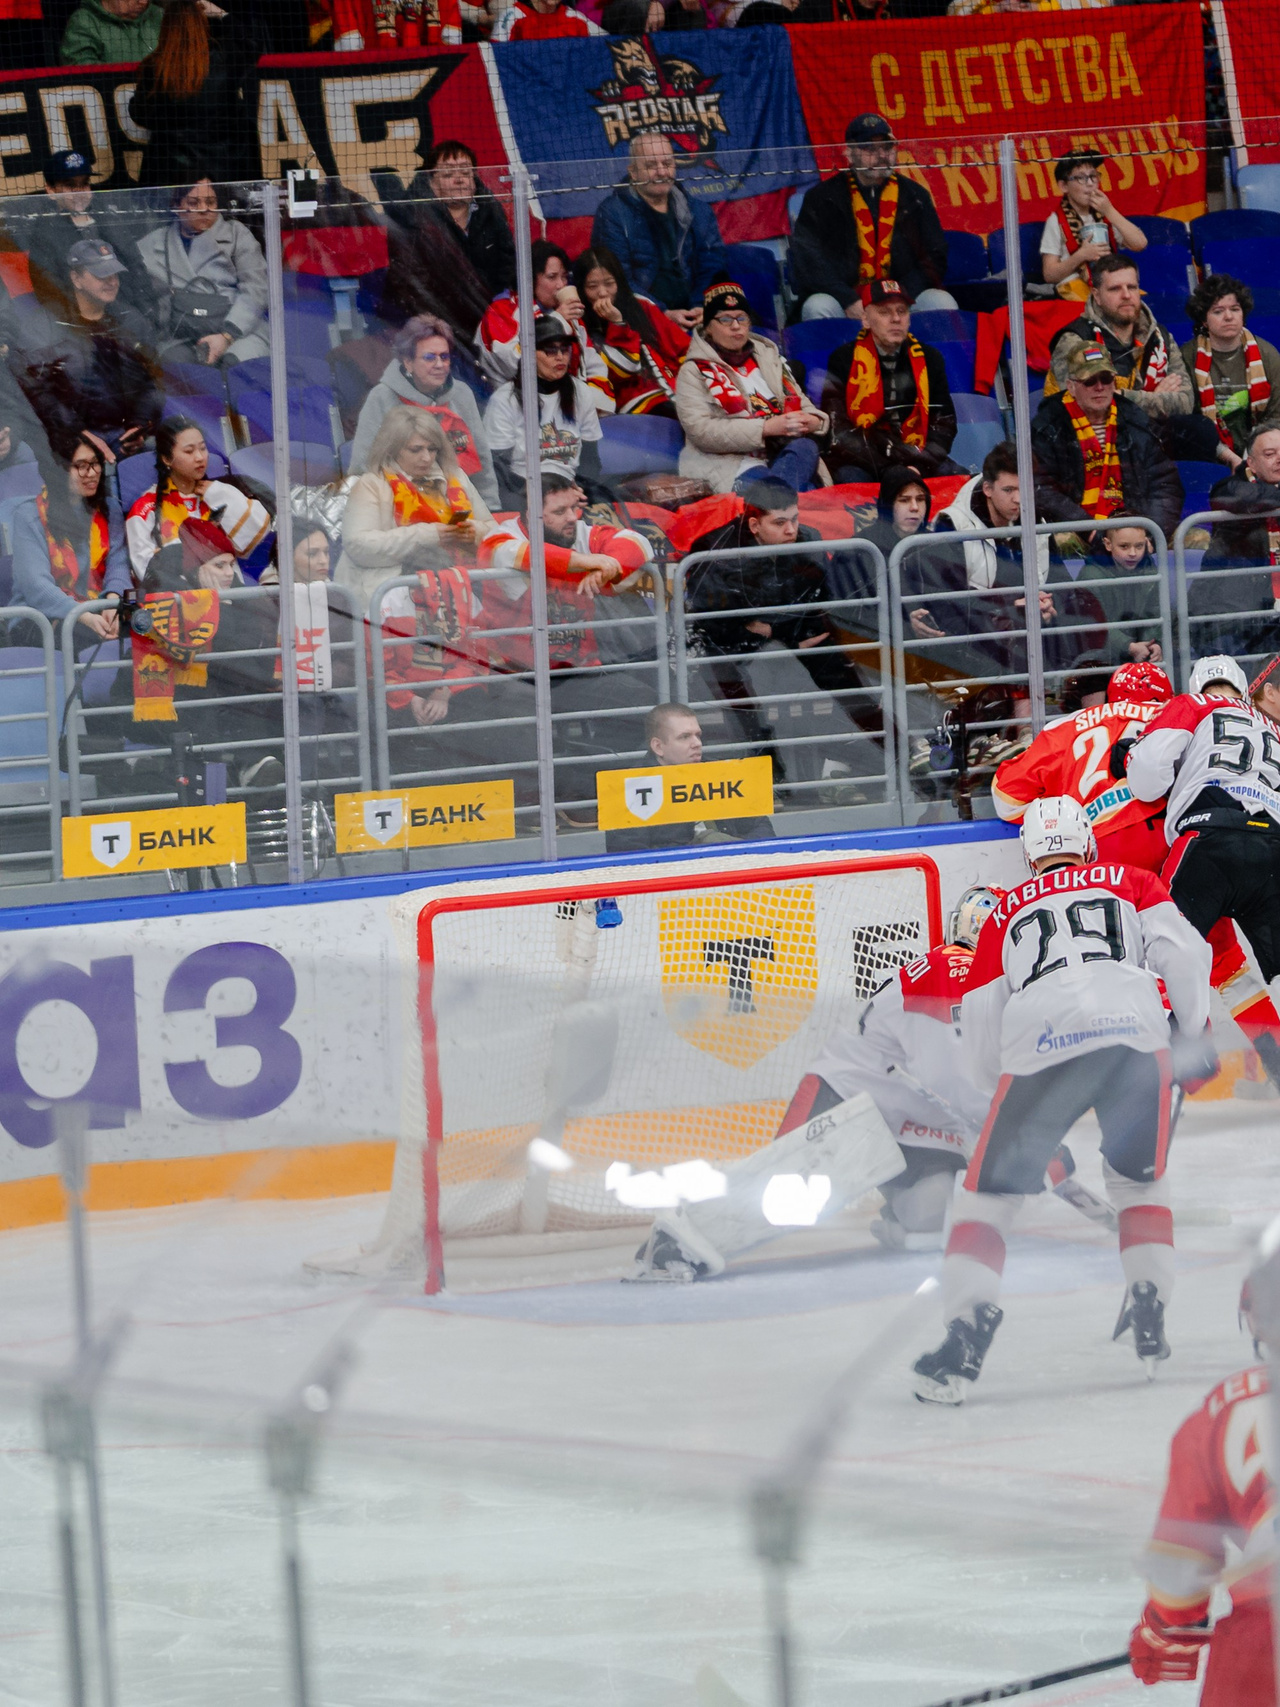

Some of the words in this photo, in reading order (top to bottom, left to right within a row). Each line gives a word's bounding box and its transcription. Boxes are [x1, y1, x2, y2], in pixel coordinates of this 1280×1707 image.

[871, 53, 906, 119] С
[920, 32, 1143, 125] ДЕТСТВА
[594, 92, 730, 147] REDSTAR
[1075, 701, 1154, 732] SHAROV
[671, 780, 745, 804] БАНК
[1086, 786, 1136, 822] SIBU
[409, 803, 486, 828] БАНК
[138, 826, 216, 852] БАНК
[1044, 835, 1064, 852] 29
[992, 865, 1125, 928] KABLUKOV
[1010, 897, 1127, 991] 29
